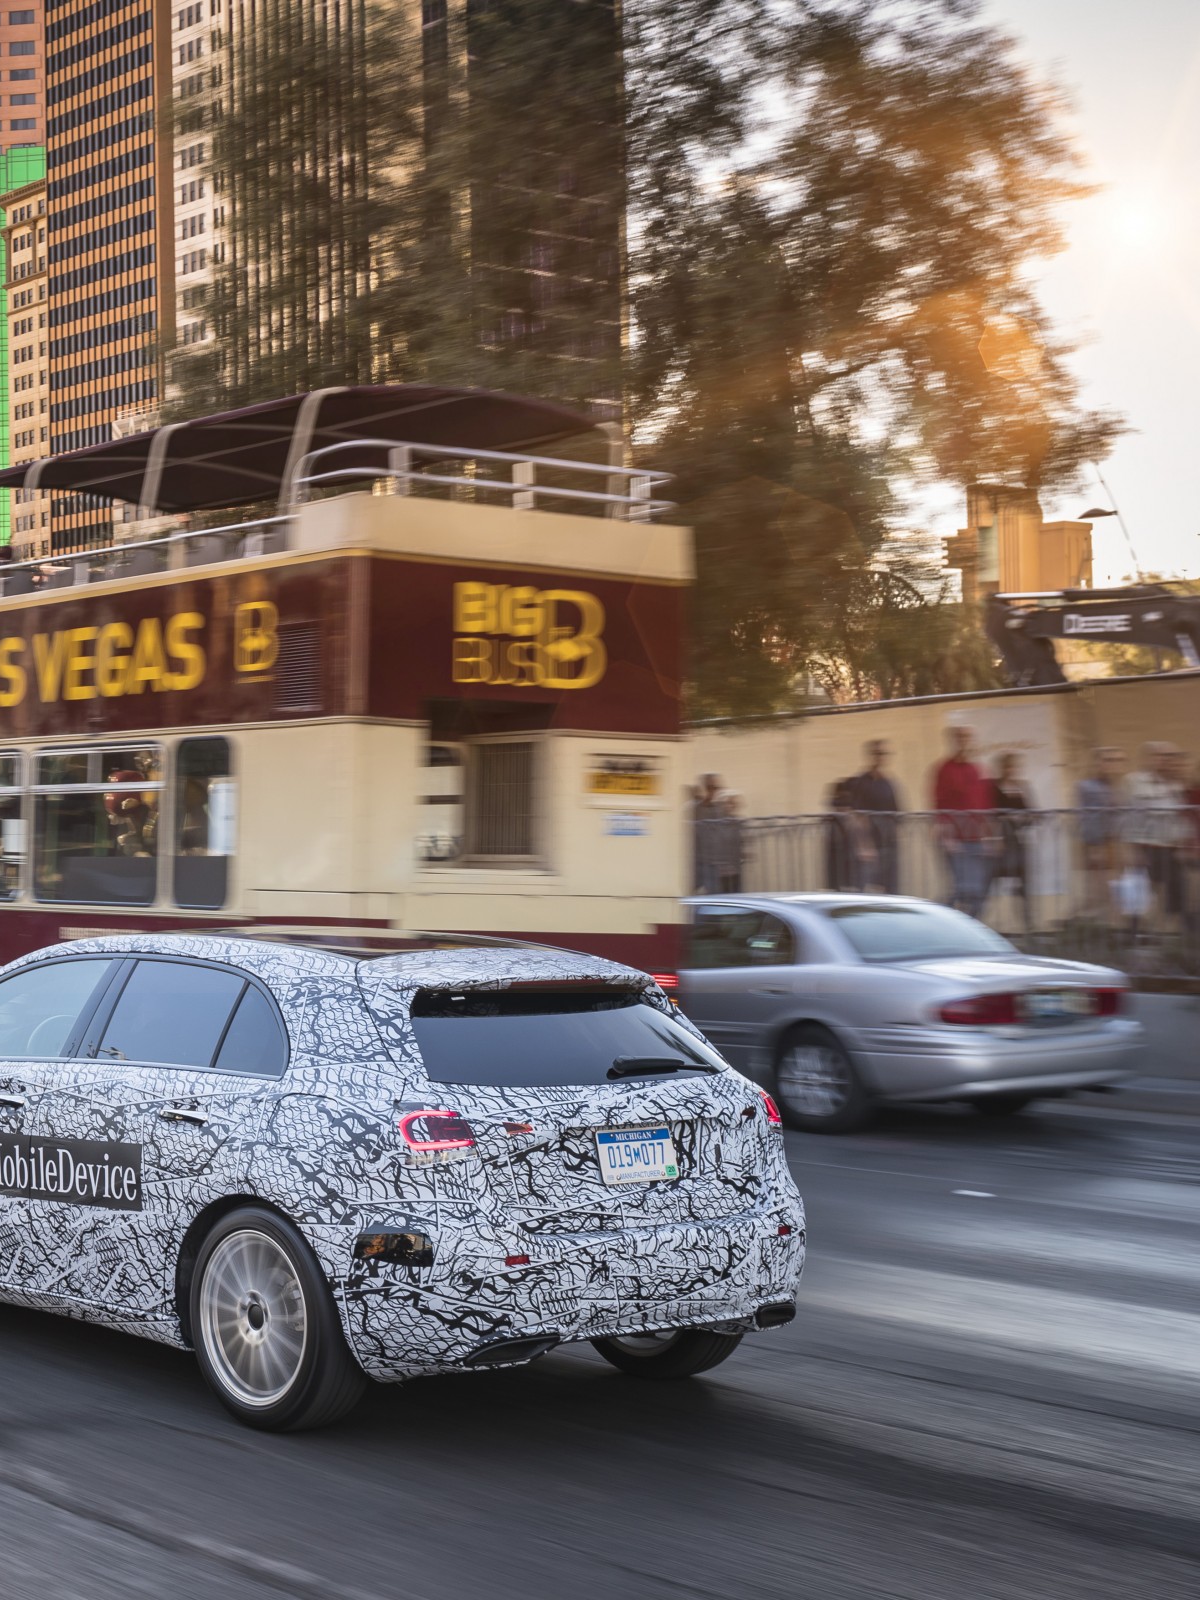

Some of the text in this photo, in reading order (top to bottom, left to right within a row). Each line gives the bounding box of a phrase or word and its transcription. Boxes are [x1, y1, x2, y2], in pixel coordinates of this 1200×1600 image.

[452, 581, 546, 637] BIG
[31, 612, 207, 703] VEGAS
[615, 1131, 652, 1141] MICHIGAN
[607, 1142, 665, 1168] 019M077
[620, 1170, 661, 1180] MANUFACTURER
